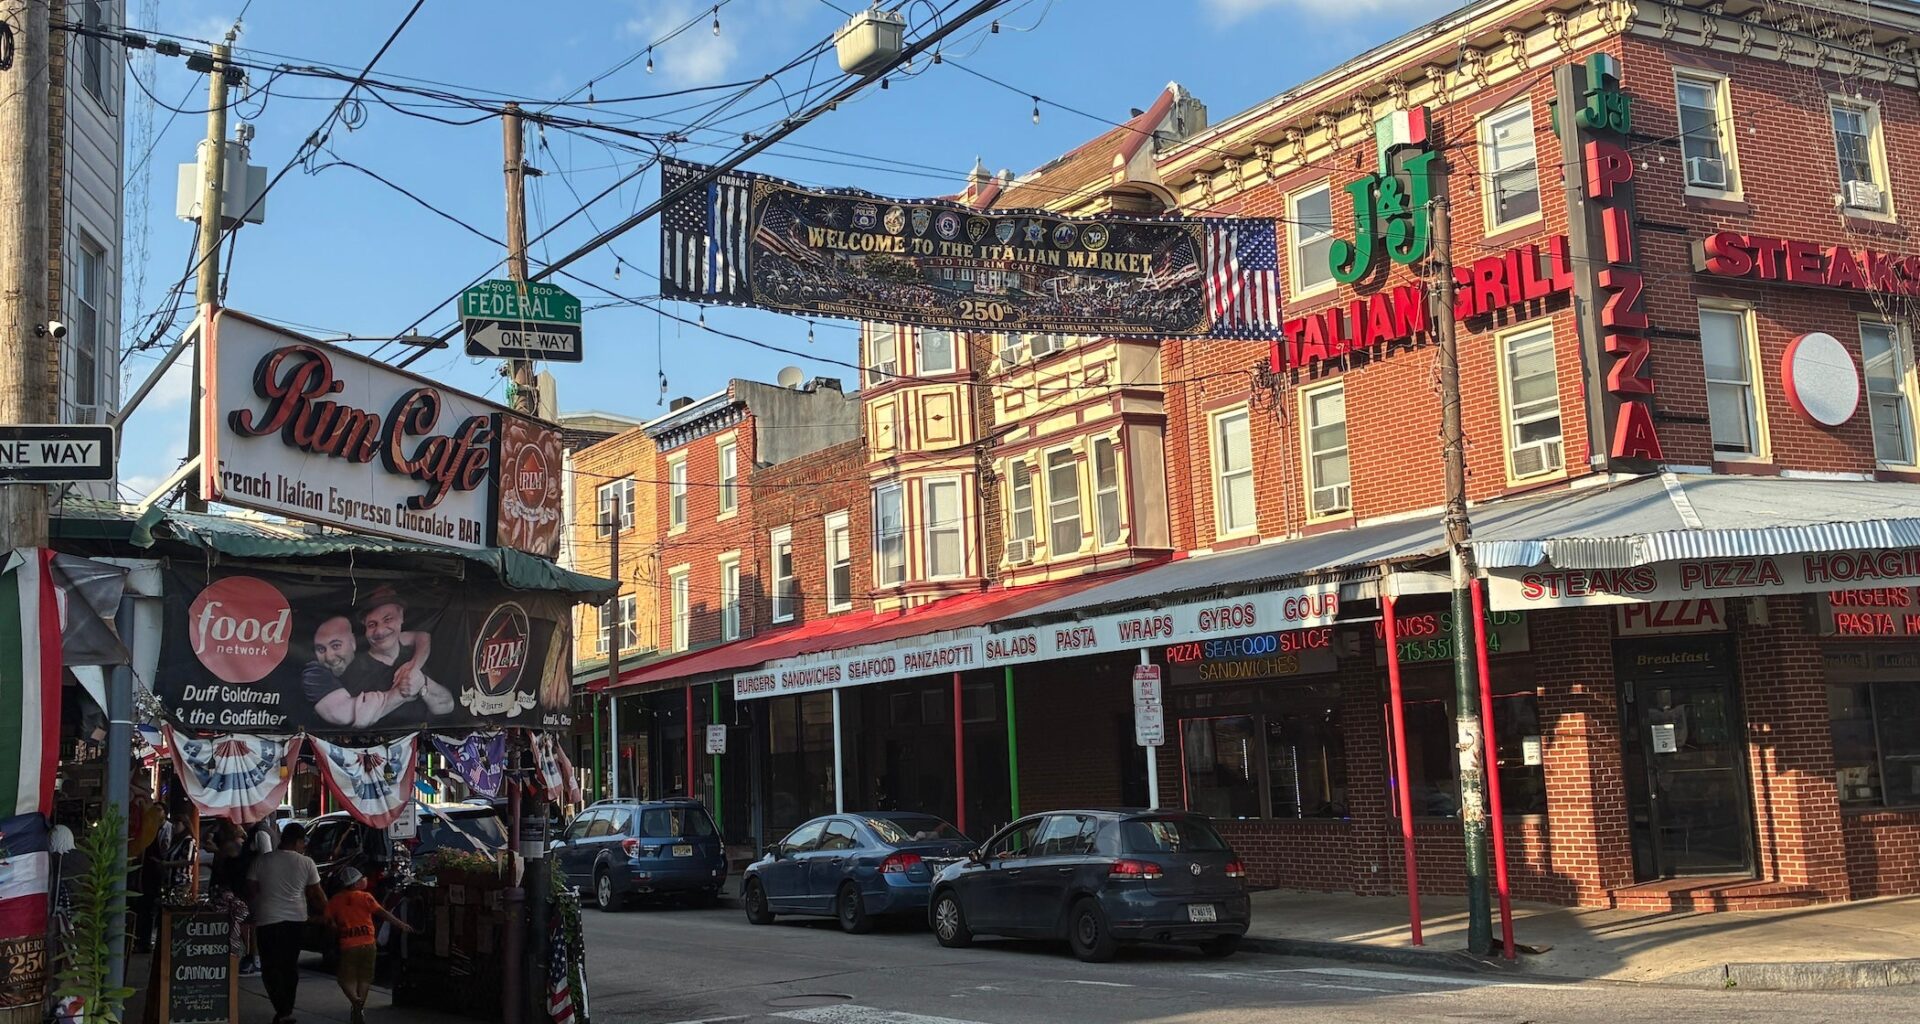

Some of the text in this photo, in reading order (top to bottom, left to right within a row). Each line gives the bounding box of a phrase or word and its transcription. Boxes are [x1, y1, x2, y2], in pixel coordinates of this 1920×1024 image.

[717, 175, 750, 188] COURAGE
[1329, 150, 1436, 283] J&J
[807, 225, 1153, 273] WELCOME TO THE ITALIAN MARKET
[939, 258, 952, 266] TO
[958, 259, 978, 267] THE
[983, 261, 1005, 269] RIM
[491, 283, 553, 295] 900 800
[1043, 275, 1101, 301] Thank
[1104, 280, 1131, 298] you
[468, 293, 578, 319] FEDERAL ST
[818, 302, 904, 320] HONORING OUR PAST
[959, 300, 1014, 322] 250th
[1270, 235, 1575, 374] ITALIAN GRILL
[1585, 140, 1664, 460] PIZZA
[921, 316, 977, 326] CELEBRATING
[501, 332, 569, 349] ONE WAY
[228, 344, 497, 510] Rim Café
[41, 443, 93, 464] WAY
[277, 474, 323, 511] Italian
[329, 486, 391, 526] Espresso
[395, 502, 454, 539] Chocolate
[458, 518, 481, 545] BAR
[1521, 566, 1656, 599] STEAKS
[1680, 558, 1784, 591] PIZZA
[1828, 587, 1912, 607] URGERS
[1624, 599, 1719, 629] PIZZA
[1839, 612, 1897, 635] PASTA
[196, 600, 291, 655] food
[986, 591, 1339, 661] SALADS PASTA WRAPS GYROS GOUR
[217, 644, 268, 656] network
[484, 640, 523, 672] RIM
[1166, 643, 1202, 664] PIZZA
[1204, 635, 1277, 658] SEAFOOD
[1637, 651, 1710, 666] Breakfast
[737, 643, 974, 696] BURGERS SANDWICHES SEAFOOD PANZAROTTI
[1199, 655, 1298, 681] SANDWICHES
[183, 684, 281, 704] Duff Goldman
[175, 707, 287, 726] & the Godfather
[186, 922, 230, 936] GELATO
[186, 944, 229, 957] ESPRESSO
[176, 965, 227, 980] CANNOLI
